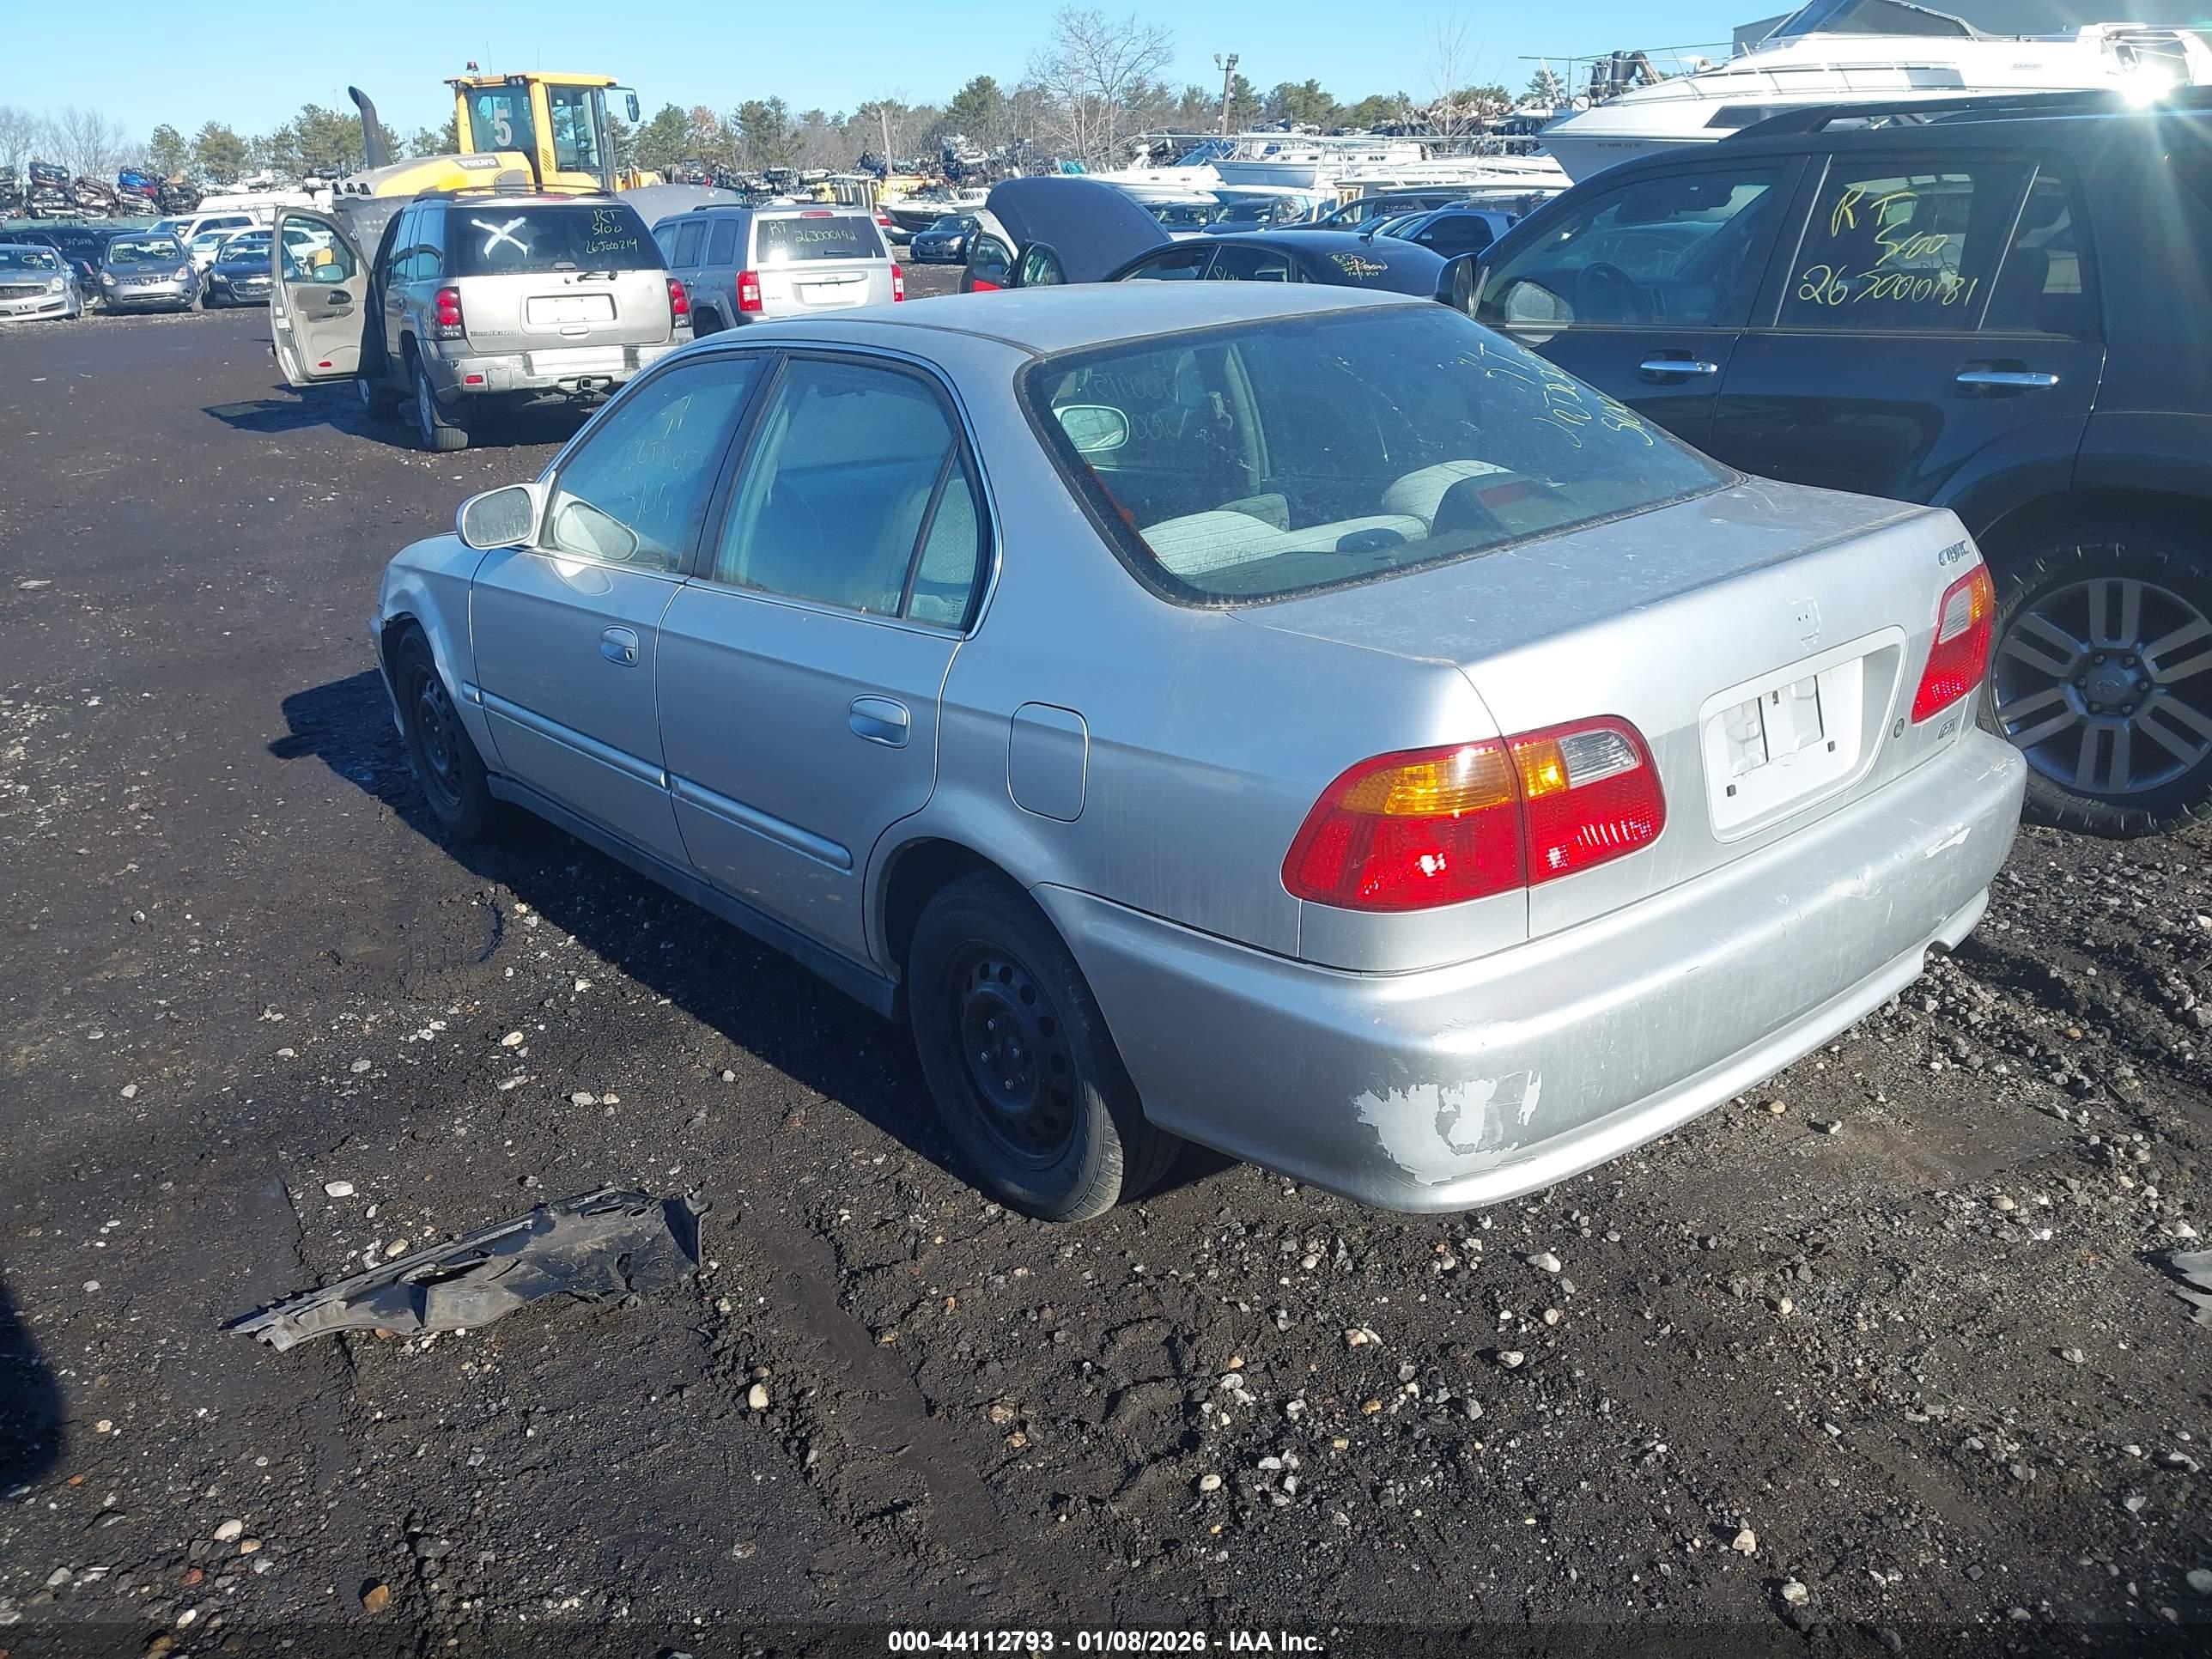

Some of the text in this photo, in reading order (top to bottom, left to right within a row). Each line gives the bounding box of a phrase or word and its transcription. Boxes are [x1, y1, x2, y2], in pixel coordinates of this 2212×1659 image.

[493, 108, 513, 147] 5
[458, 158, 497, 167] VOLVO
[592, 209, 623, 223] RT
[1832, 185, 1917, 237] RT
[768, 222, 787, 236] RT
[1938, 539, 1970, 567] CIVIC
